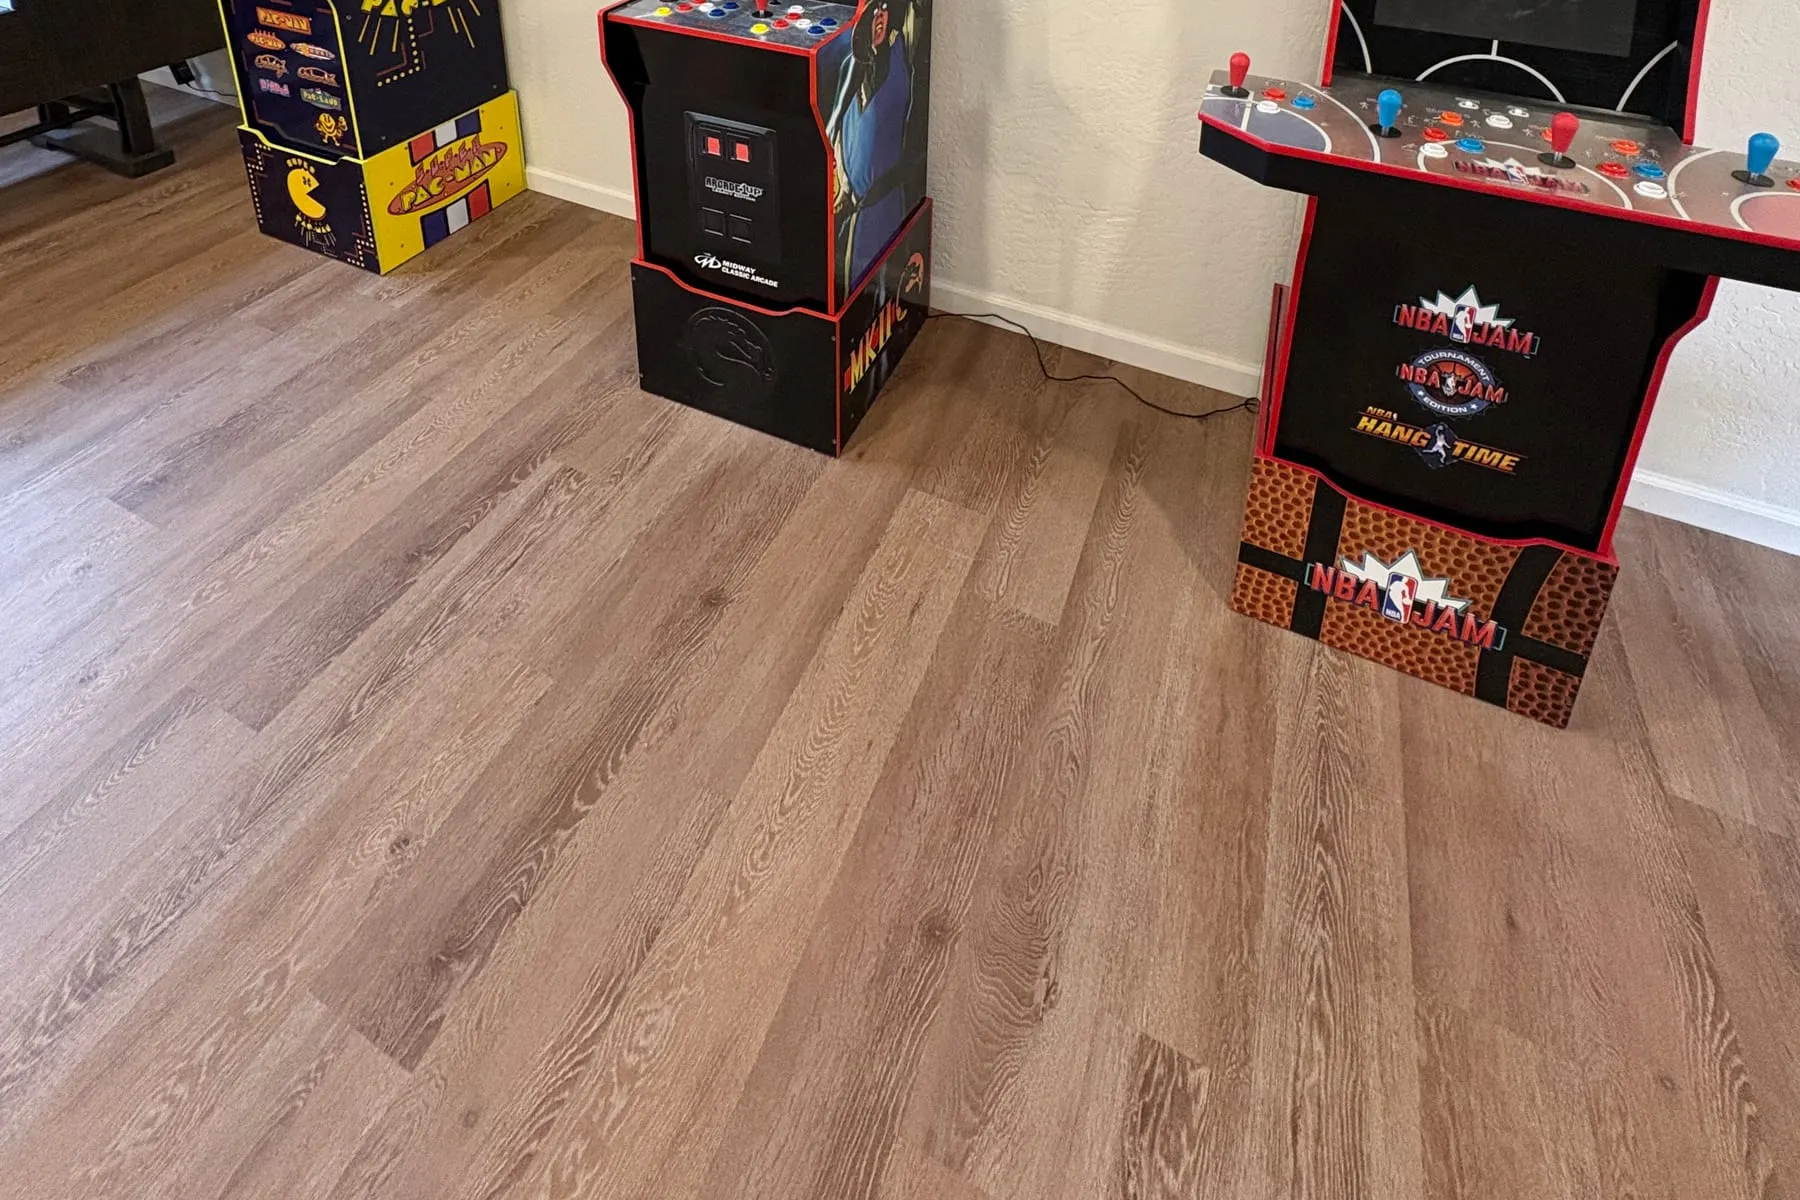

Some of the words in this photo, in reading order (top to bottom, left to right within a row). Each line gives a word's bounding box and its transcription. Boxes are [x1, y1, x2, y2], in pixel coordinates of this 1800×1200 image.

[401, 147, 497, 213] PAC-MAN
[721, 266, 751, 280] CLASSIC
[750, 275, 779, 288] ARCADE
[722, 260, 756, 274] MIDWAY
[849, 297, 893, 395] MKII
[1398, 303, 1449, 336] NBA
[1470, 321, 1534, 354] JAM
[1400, 363, 1440, 388] NBA
[1458, 377, 1505, 403] JAM
[1418, 351, 1491, 382] TOURNAMENT
[1366, 406, 1392, 419] NBA
[1422, 396, 1468, 413] EDITION
[1356, 416, 1431, 448] HANG
[1452, 441, 1521, 472] TIME
[1311, 562, 1380, 611] NBA
[1411, 599, 1498, 649] JAM
